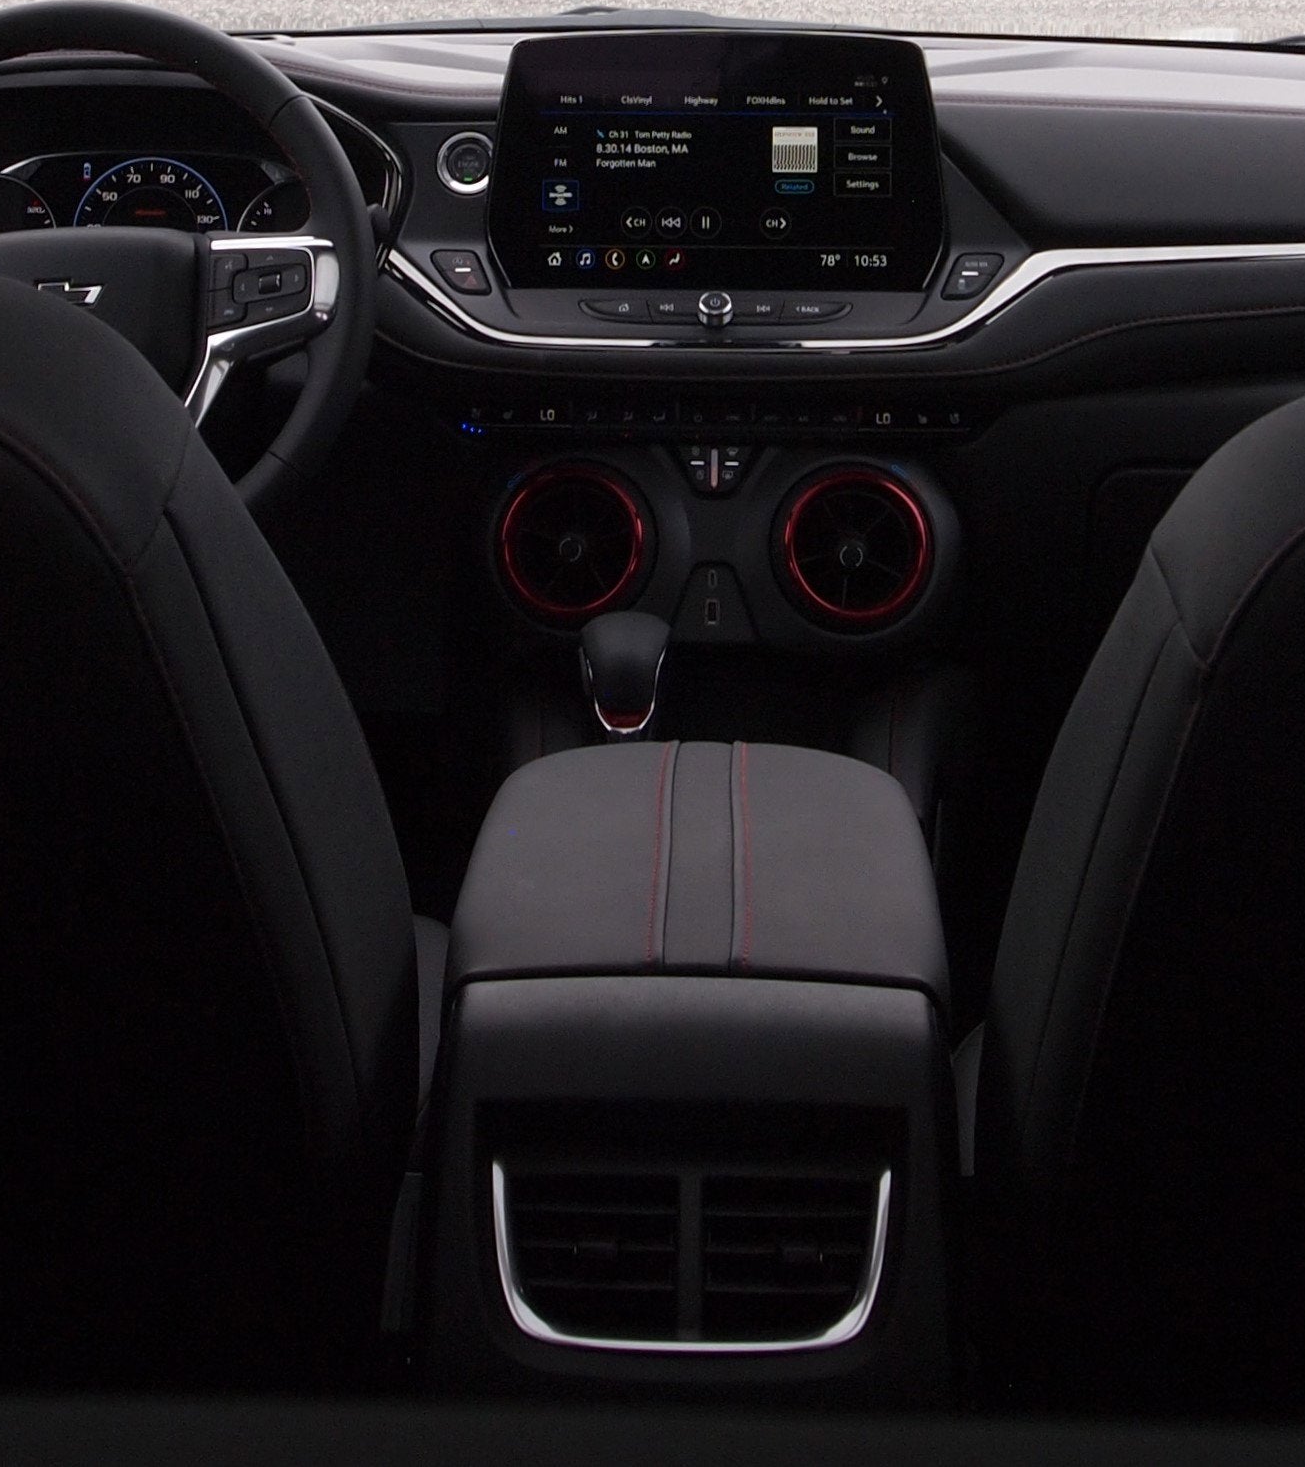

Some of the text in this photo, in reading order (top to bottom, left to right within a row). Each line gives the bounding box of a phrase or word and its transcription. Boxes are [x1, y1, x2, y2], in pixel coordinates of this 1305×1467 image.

[560, 96, 577, 104] Hits
[684, 95, 718, 106] Highway
[809, 97, 853, 106] Hold to Set
[554, 126, 568, 135] AM
[850, 125, 876, 135] Sound
[609, 131, 692, 141] Ch 31 Tom Petty Radio
[596, 144, 689, 155] 8.30.14 Boston, MA
[848, 153, 877, 162] Browse
[554, 159, 567, 167] FM
[596, 159, 656, 169] Forgotten Man
[127, 174, 142, 184] 70
[160, 174, 175, 184] 90
[846, 180, 879, 191] Settings
[102, 191, 118, 201] 50
[185, 189, 199, 199] 110
[197, 215, 213, 224] 130
[634, 218, 646, 226] CH
[766, 220, 778, 228] CH
[820, 254, 887, 267] 78° 10:53
